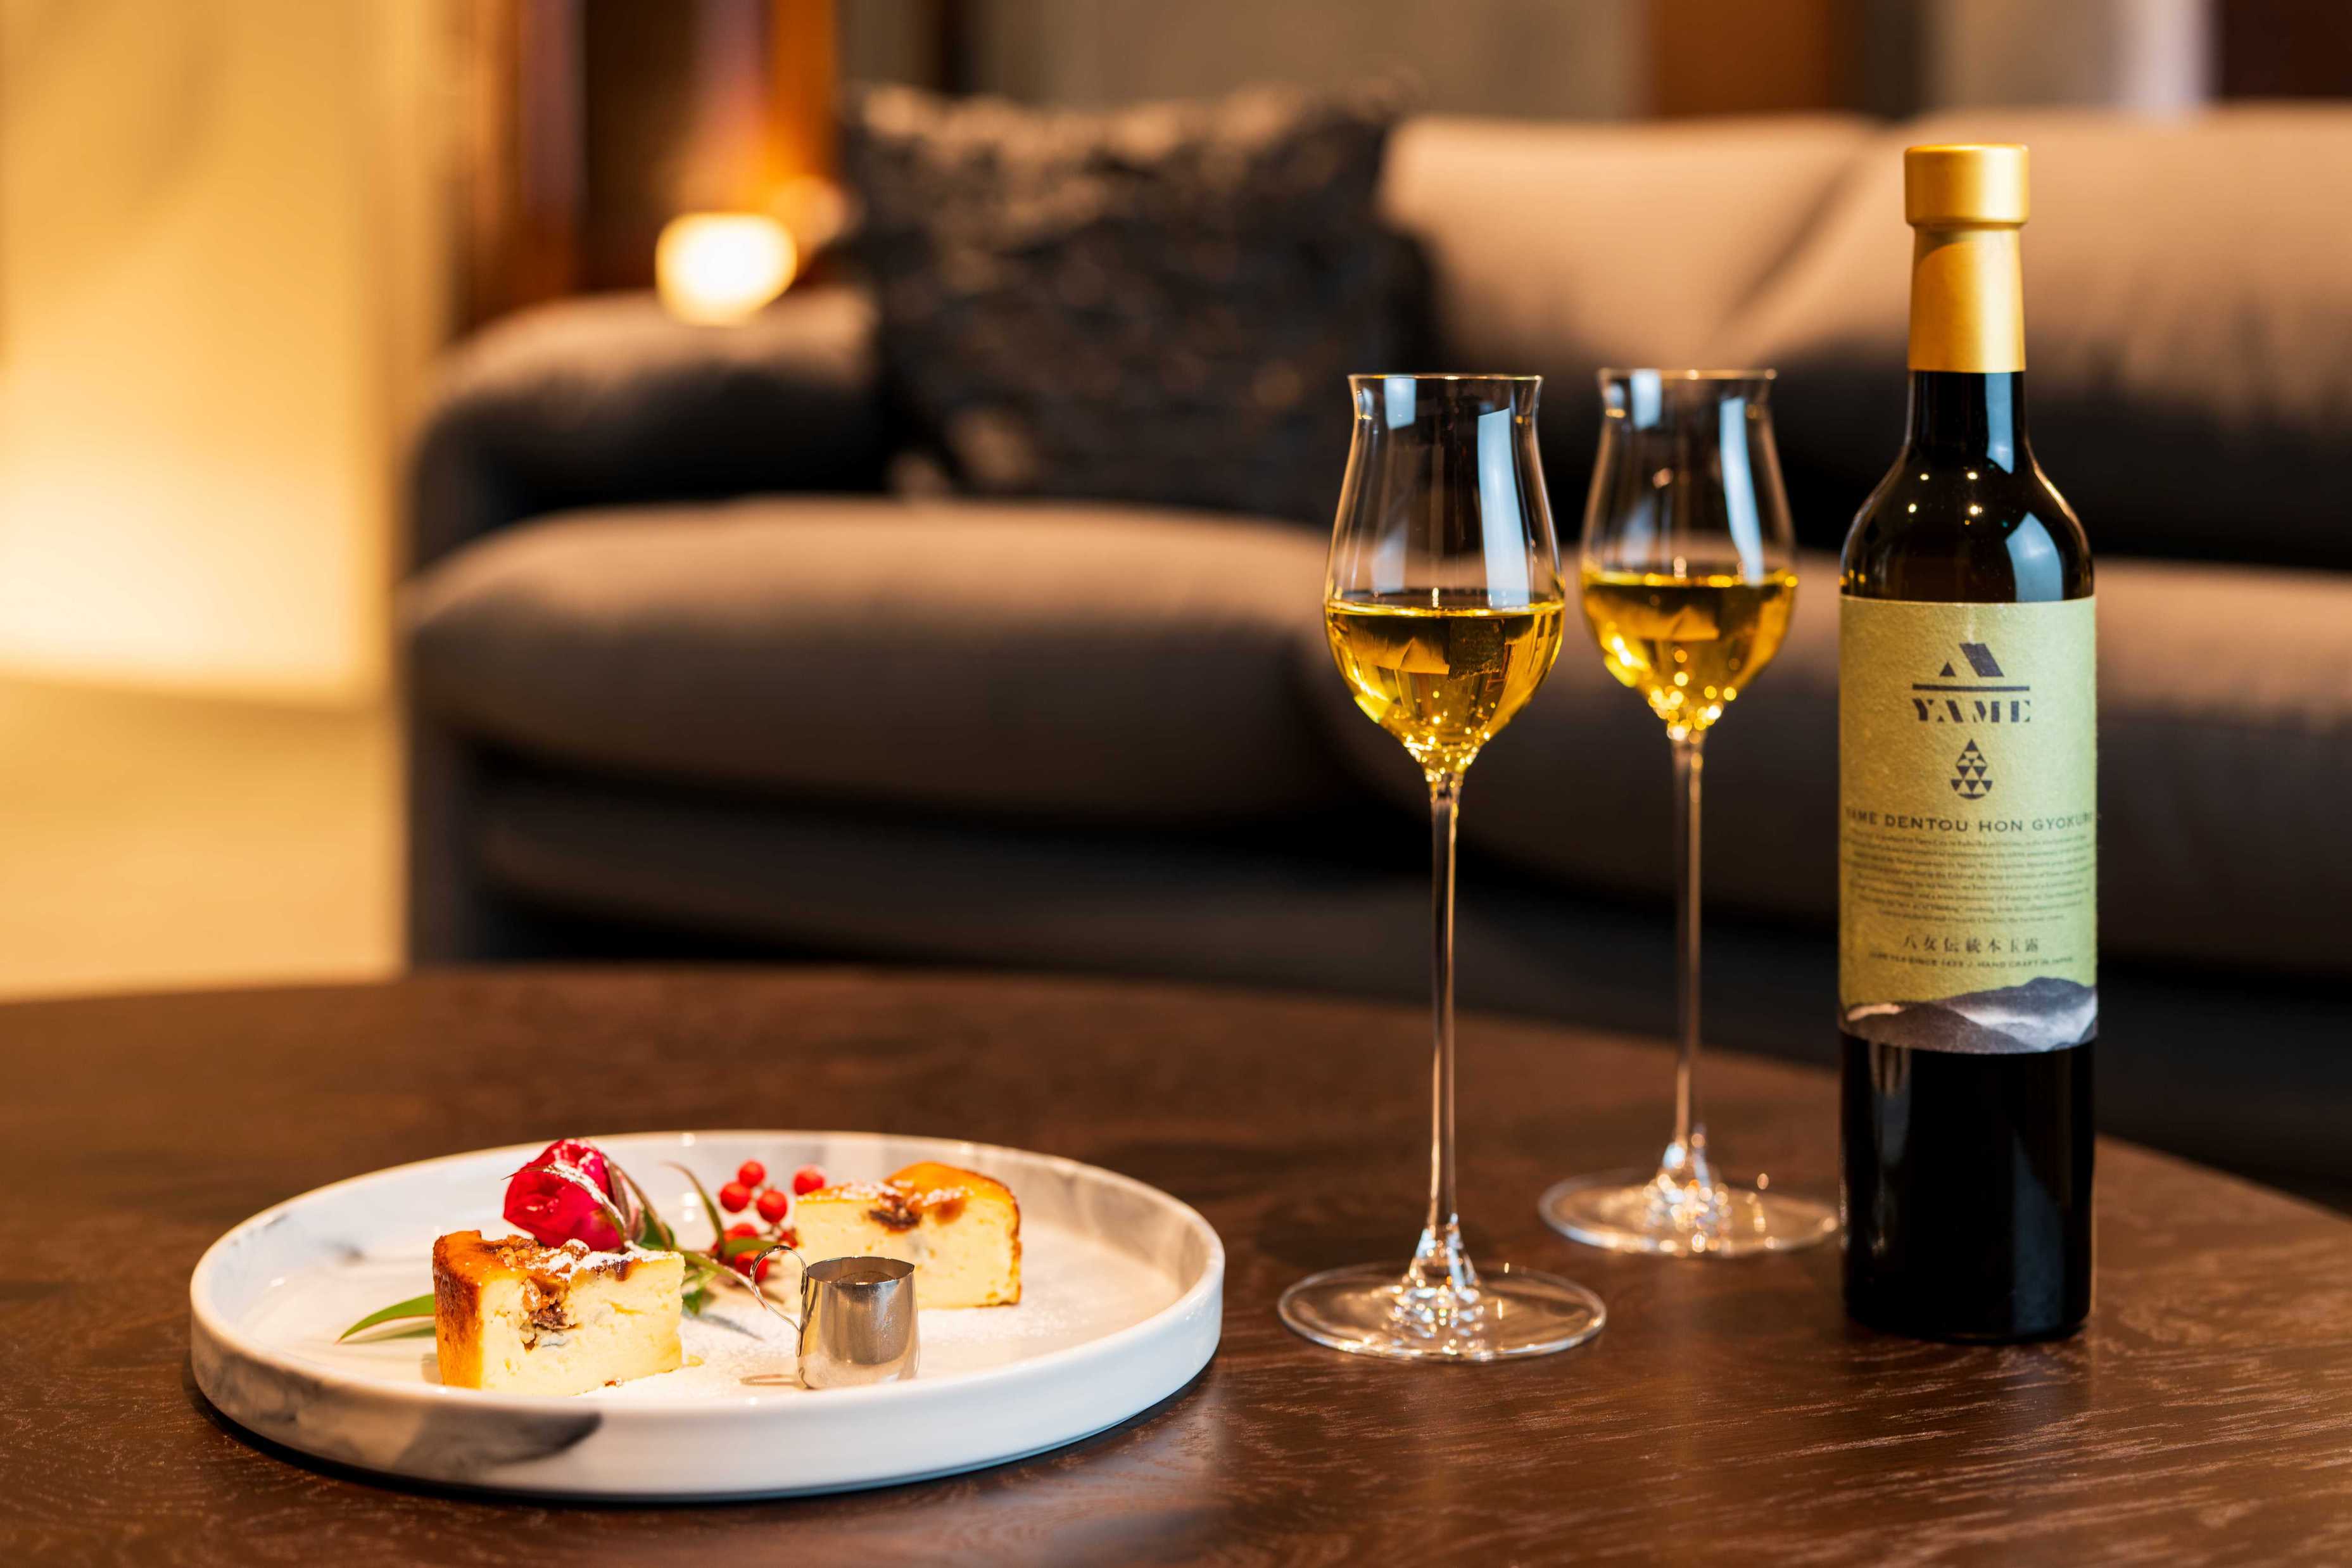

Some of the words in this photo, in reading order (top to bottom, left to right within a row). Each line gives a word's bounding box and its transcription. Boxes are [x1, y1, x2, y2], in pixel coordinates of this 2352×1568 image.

[1912, 699, 2031, 723] YAME
[1885, 814, 1968, 832] DENTOU
[1978, 819, 2023, 832] HON
